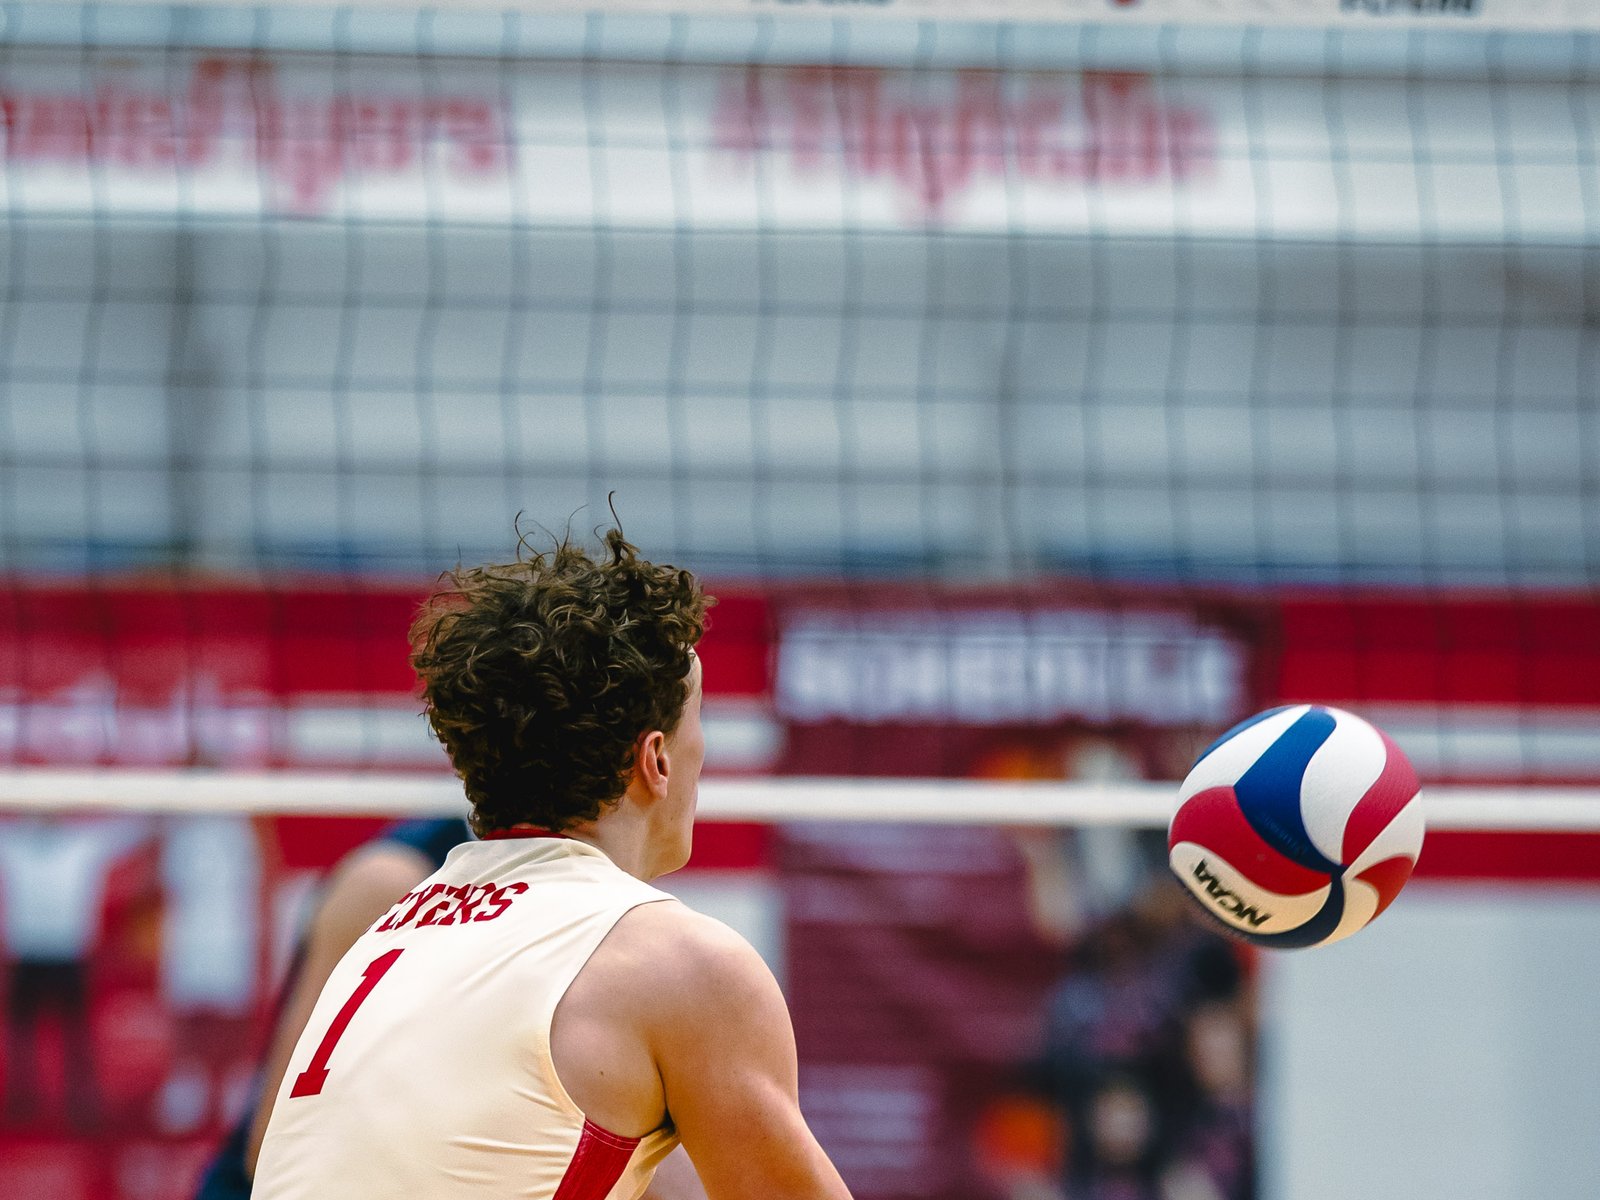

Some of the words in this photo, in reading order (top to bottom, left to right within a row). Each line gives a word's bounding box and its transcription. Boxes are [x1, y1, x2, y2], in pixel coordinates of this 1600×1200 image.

[370, 881, 530, 933] LYERS
[1191, 858, 1272, 928] NCAA
[289, 948, 406, 1099] 1
